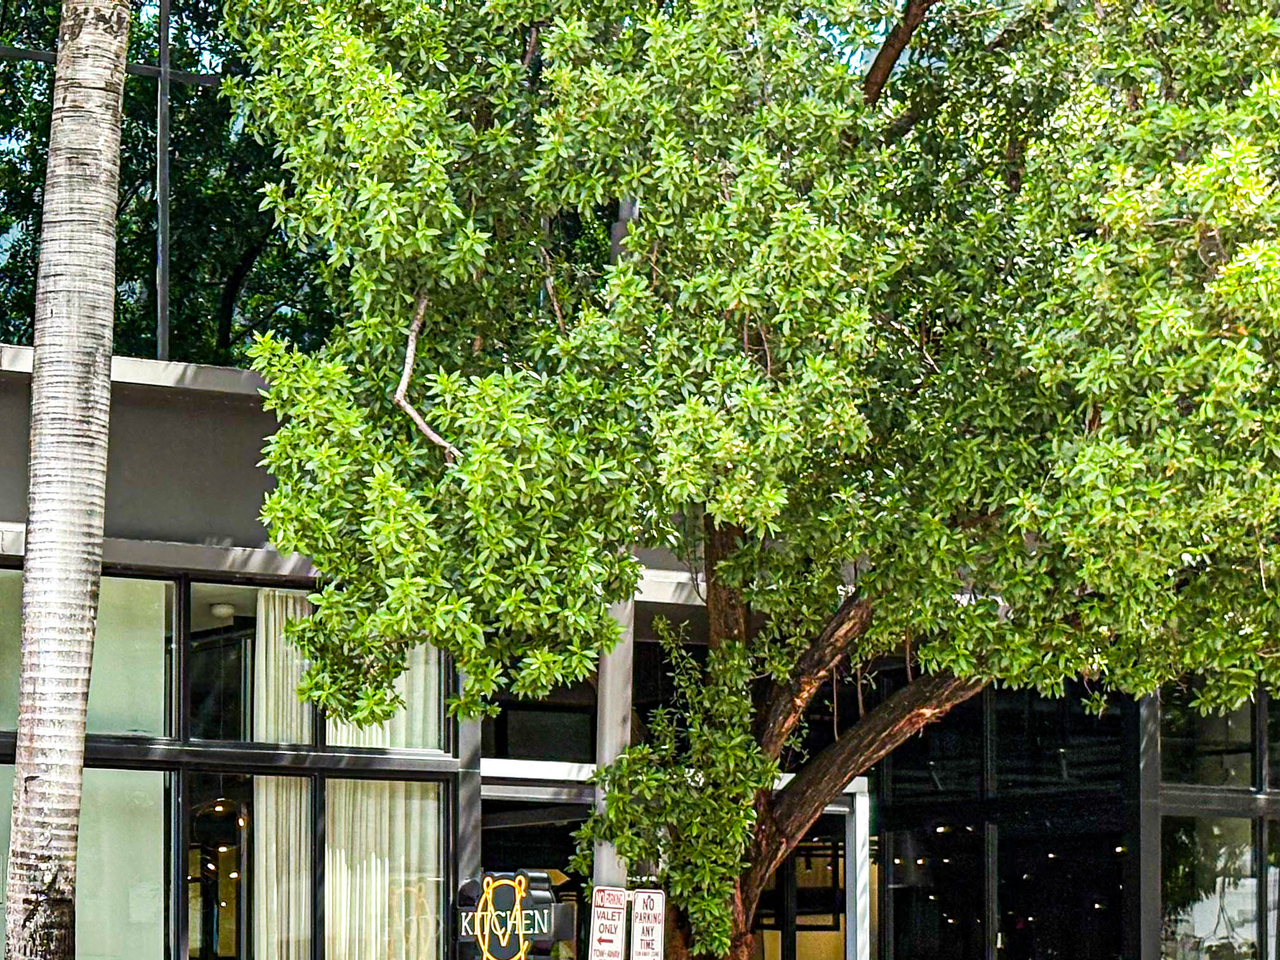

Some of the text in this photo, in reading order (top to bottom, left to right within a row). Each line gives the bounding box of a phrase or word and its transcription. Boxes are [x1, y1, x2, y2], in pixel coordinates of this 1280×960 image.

[595, 890, 605, 907] NO
[642, 897, 655, 911] NO
[461, 909, 549, 936] KITCHEN
[596, 910, 622, 922] VALET
[634, 911, 662, 925] PARKING
[598, 923, 618, 935] ONLY
[640, 925, 655, 937] ANY
[640, 938, 655, 951] TIME
